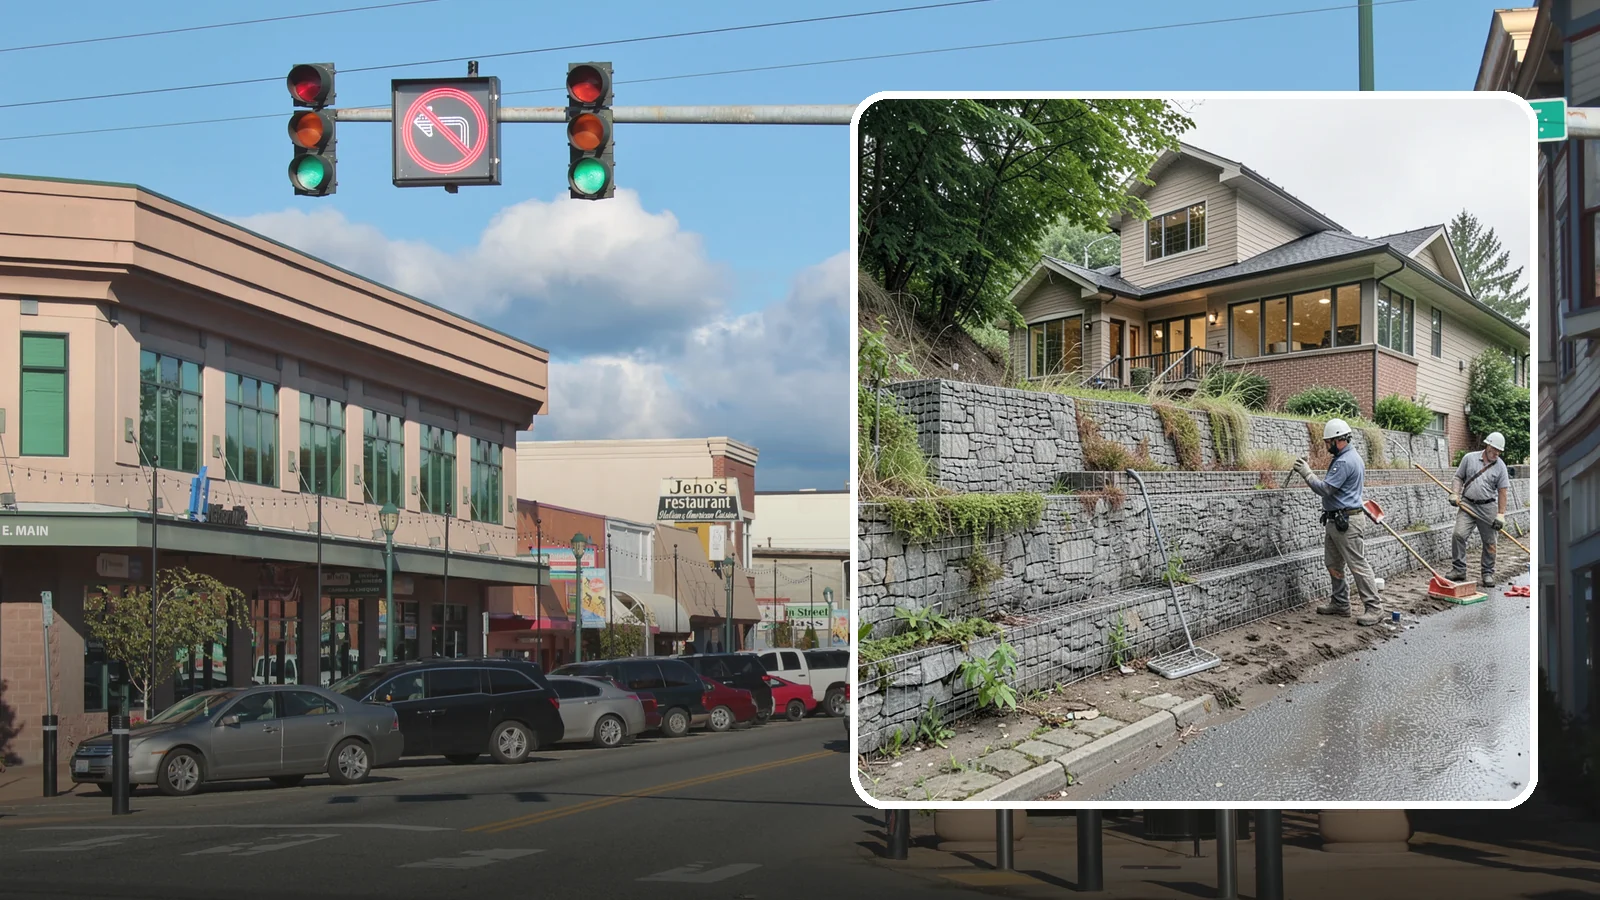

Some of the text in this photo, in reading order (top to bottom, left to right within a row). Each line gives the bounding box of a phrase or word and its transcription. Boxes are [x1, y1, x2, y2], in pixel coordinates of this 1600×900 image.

[669, 479, 728, 495] Jeno's
[665, 496, 731, 509] restaurant
[658, 509, 681, 519] Italian
[686, 509, 714, 519] American
[715, 509, 738, 519] Cuisine
[2, 525, 49, 536] E. MAIN
[797, 607, 828, 617] Street
